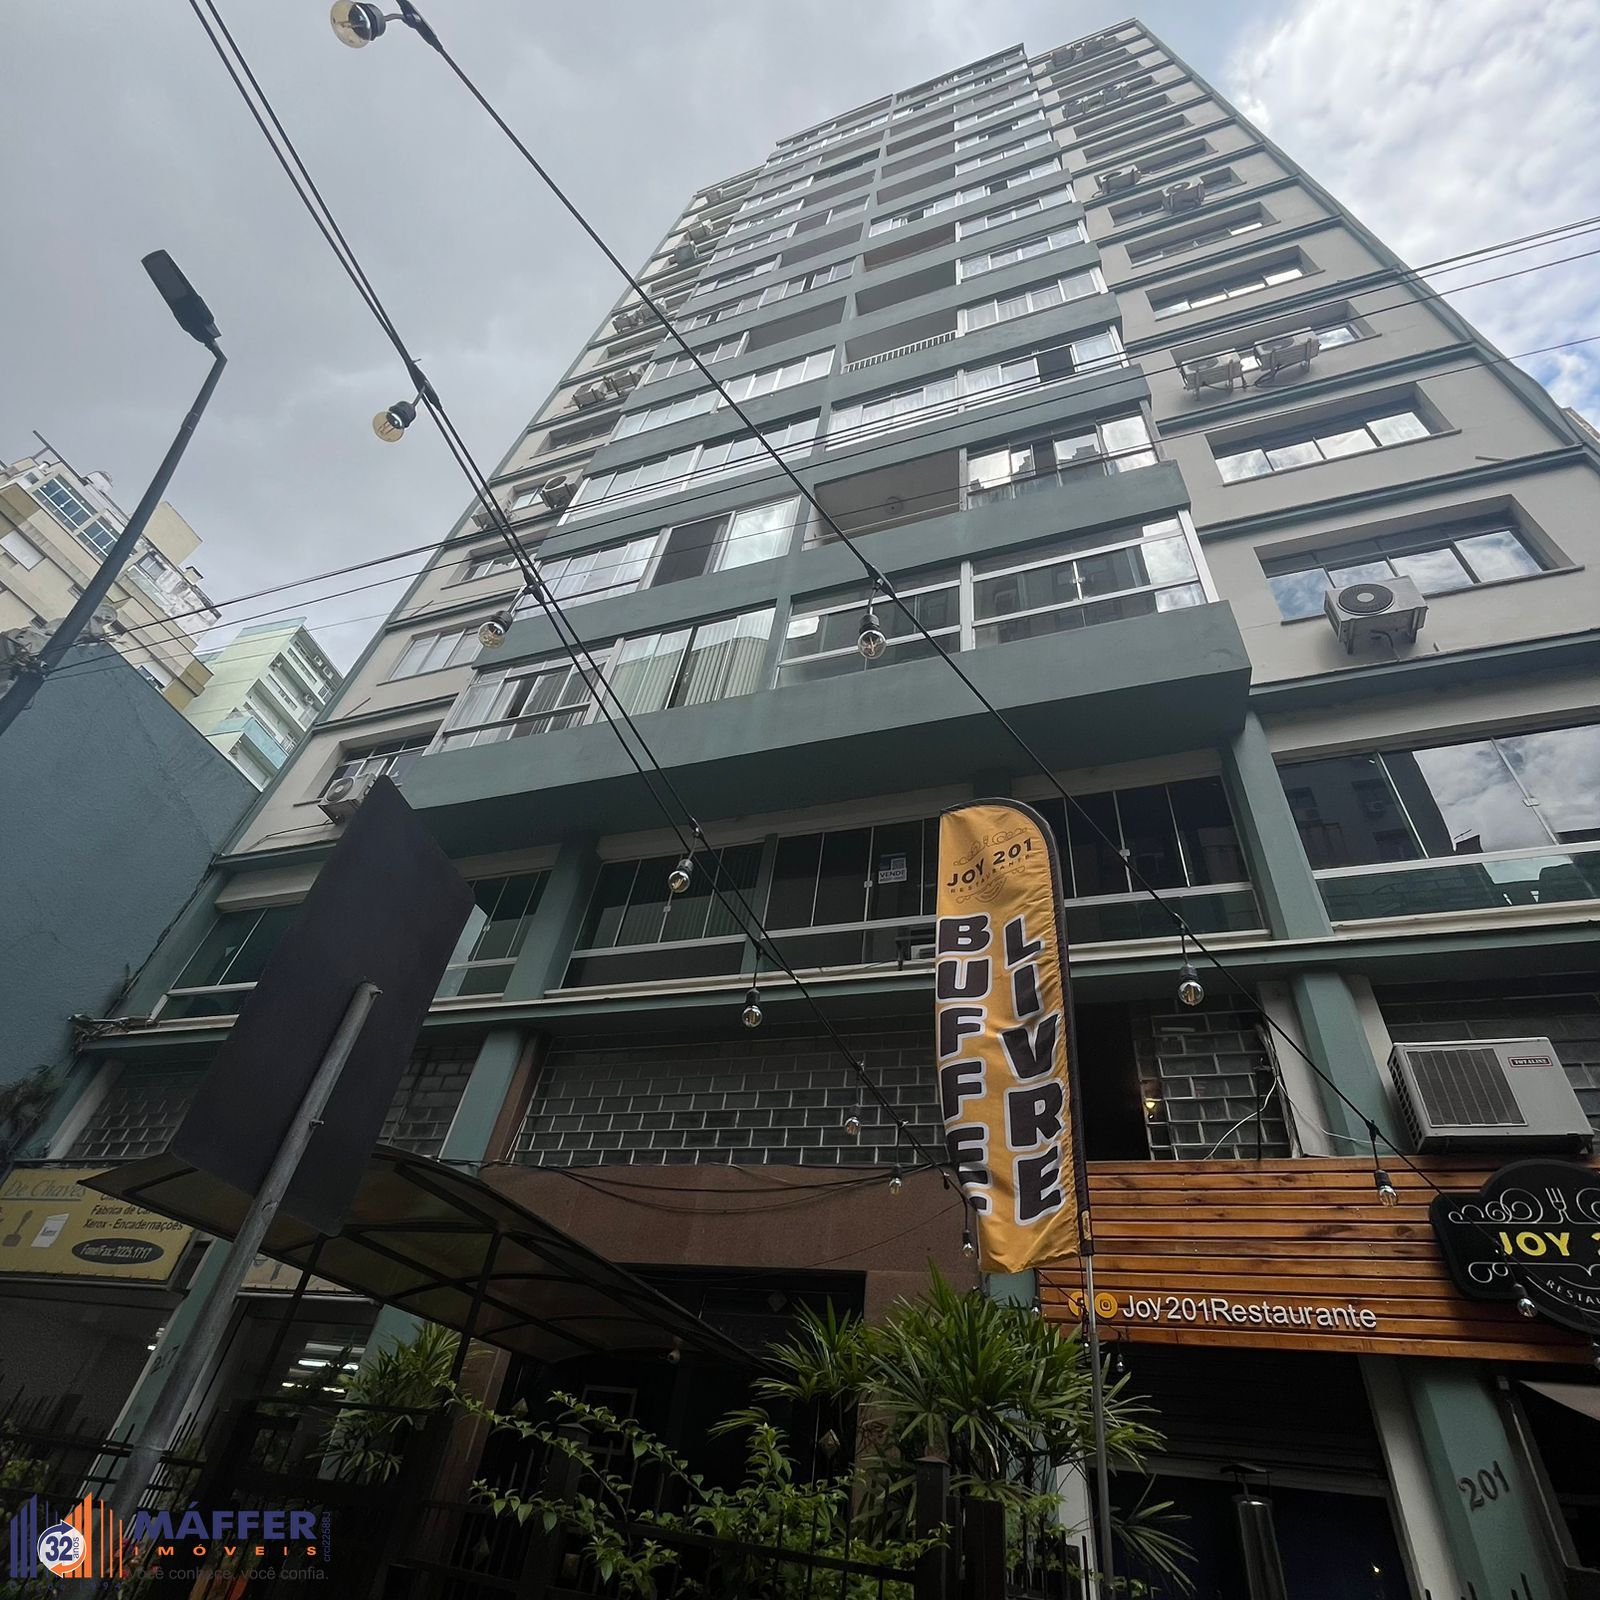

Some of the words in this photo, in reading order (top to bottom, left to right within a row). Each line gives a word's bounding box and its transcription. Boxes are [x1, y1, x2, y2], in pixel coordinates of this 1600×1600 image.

[947, 858, 984, 887] JOY
[993, 838, 1032, 865] 201
[998, 913, 1066, 1226] LIVRE
[1459, 1459, 1510, 1512] 201
